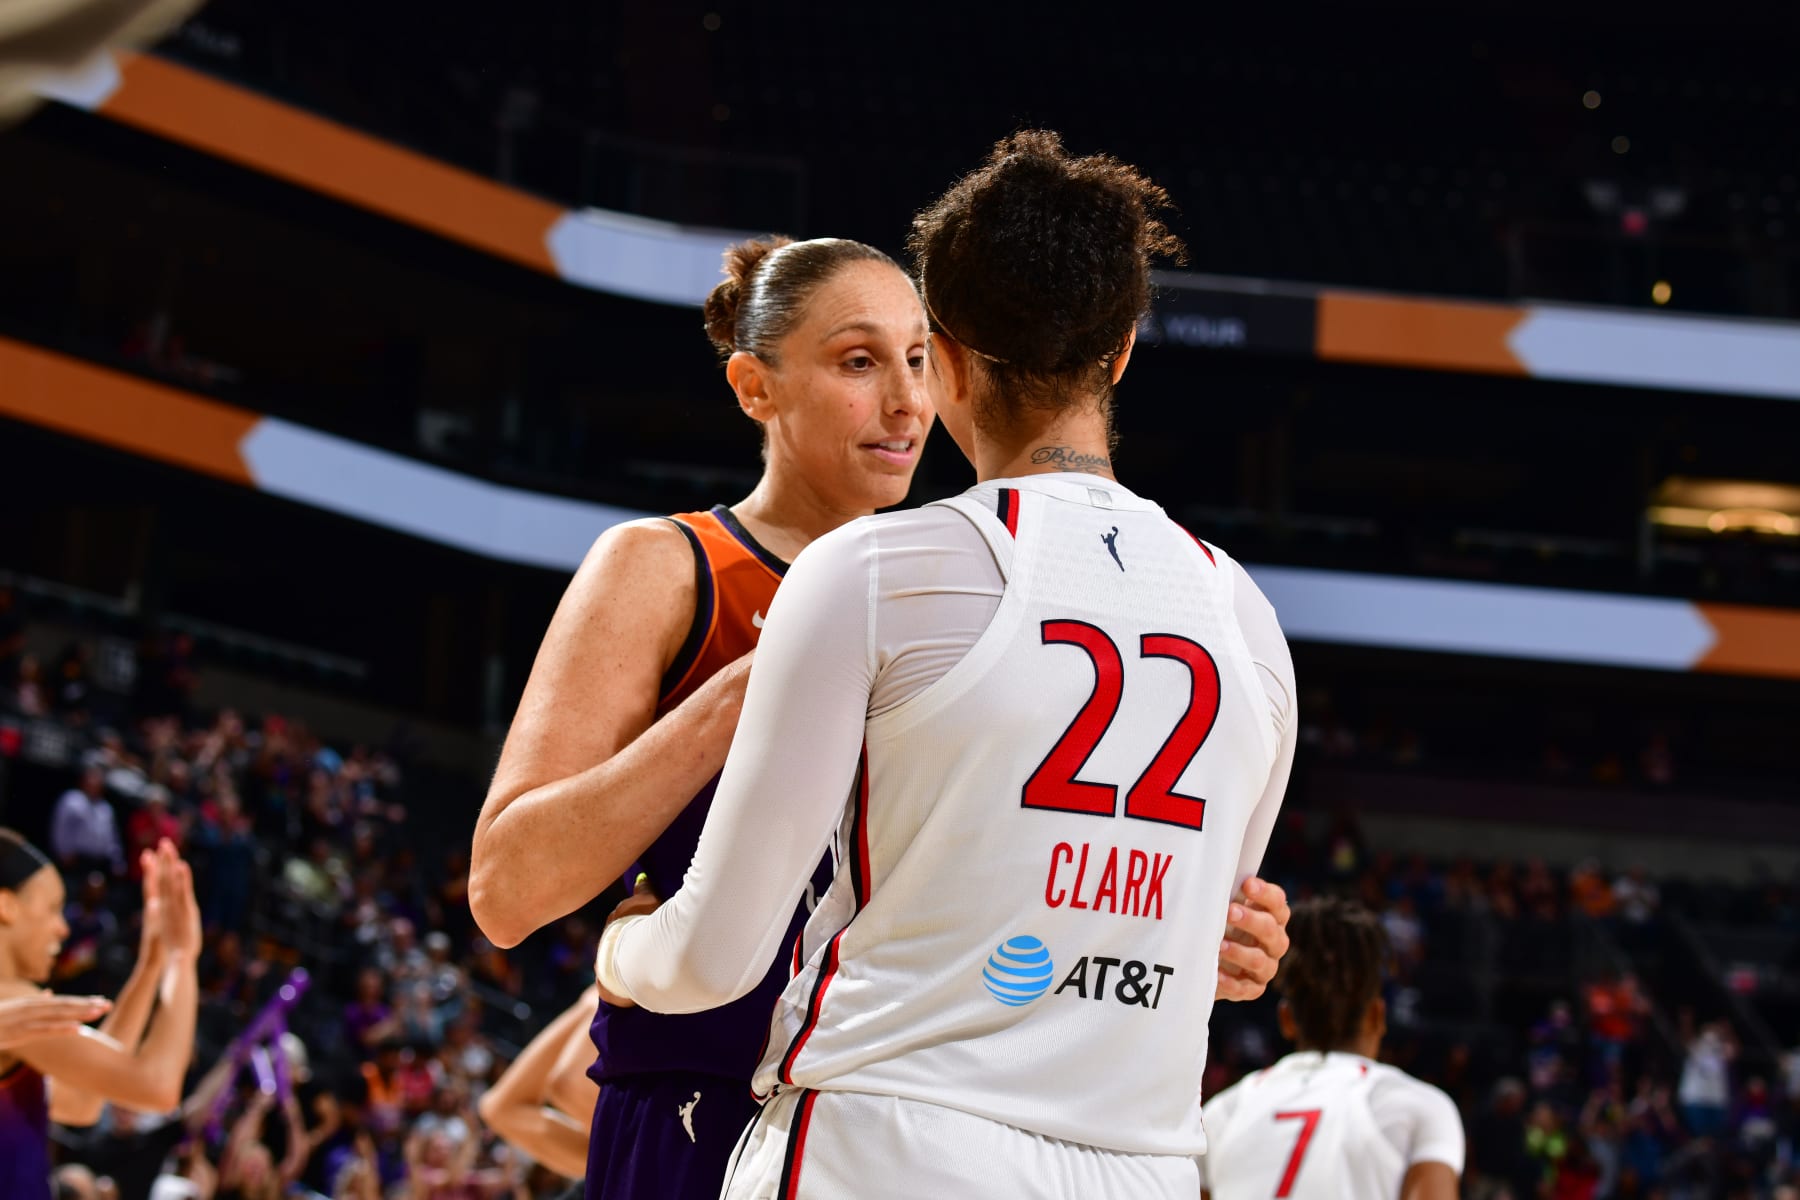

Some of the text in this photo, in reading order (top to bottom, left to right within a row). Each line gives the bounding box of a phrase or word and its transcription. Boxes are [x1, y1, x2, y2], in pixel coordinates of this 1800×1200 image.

[1021, 618, 1221, 832] 22
[1045, 841, 1173, 920] CLARK
[1054, 956, 1174, 1010] AT&T
[1274, 1108, 1323, 1199] 7
